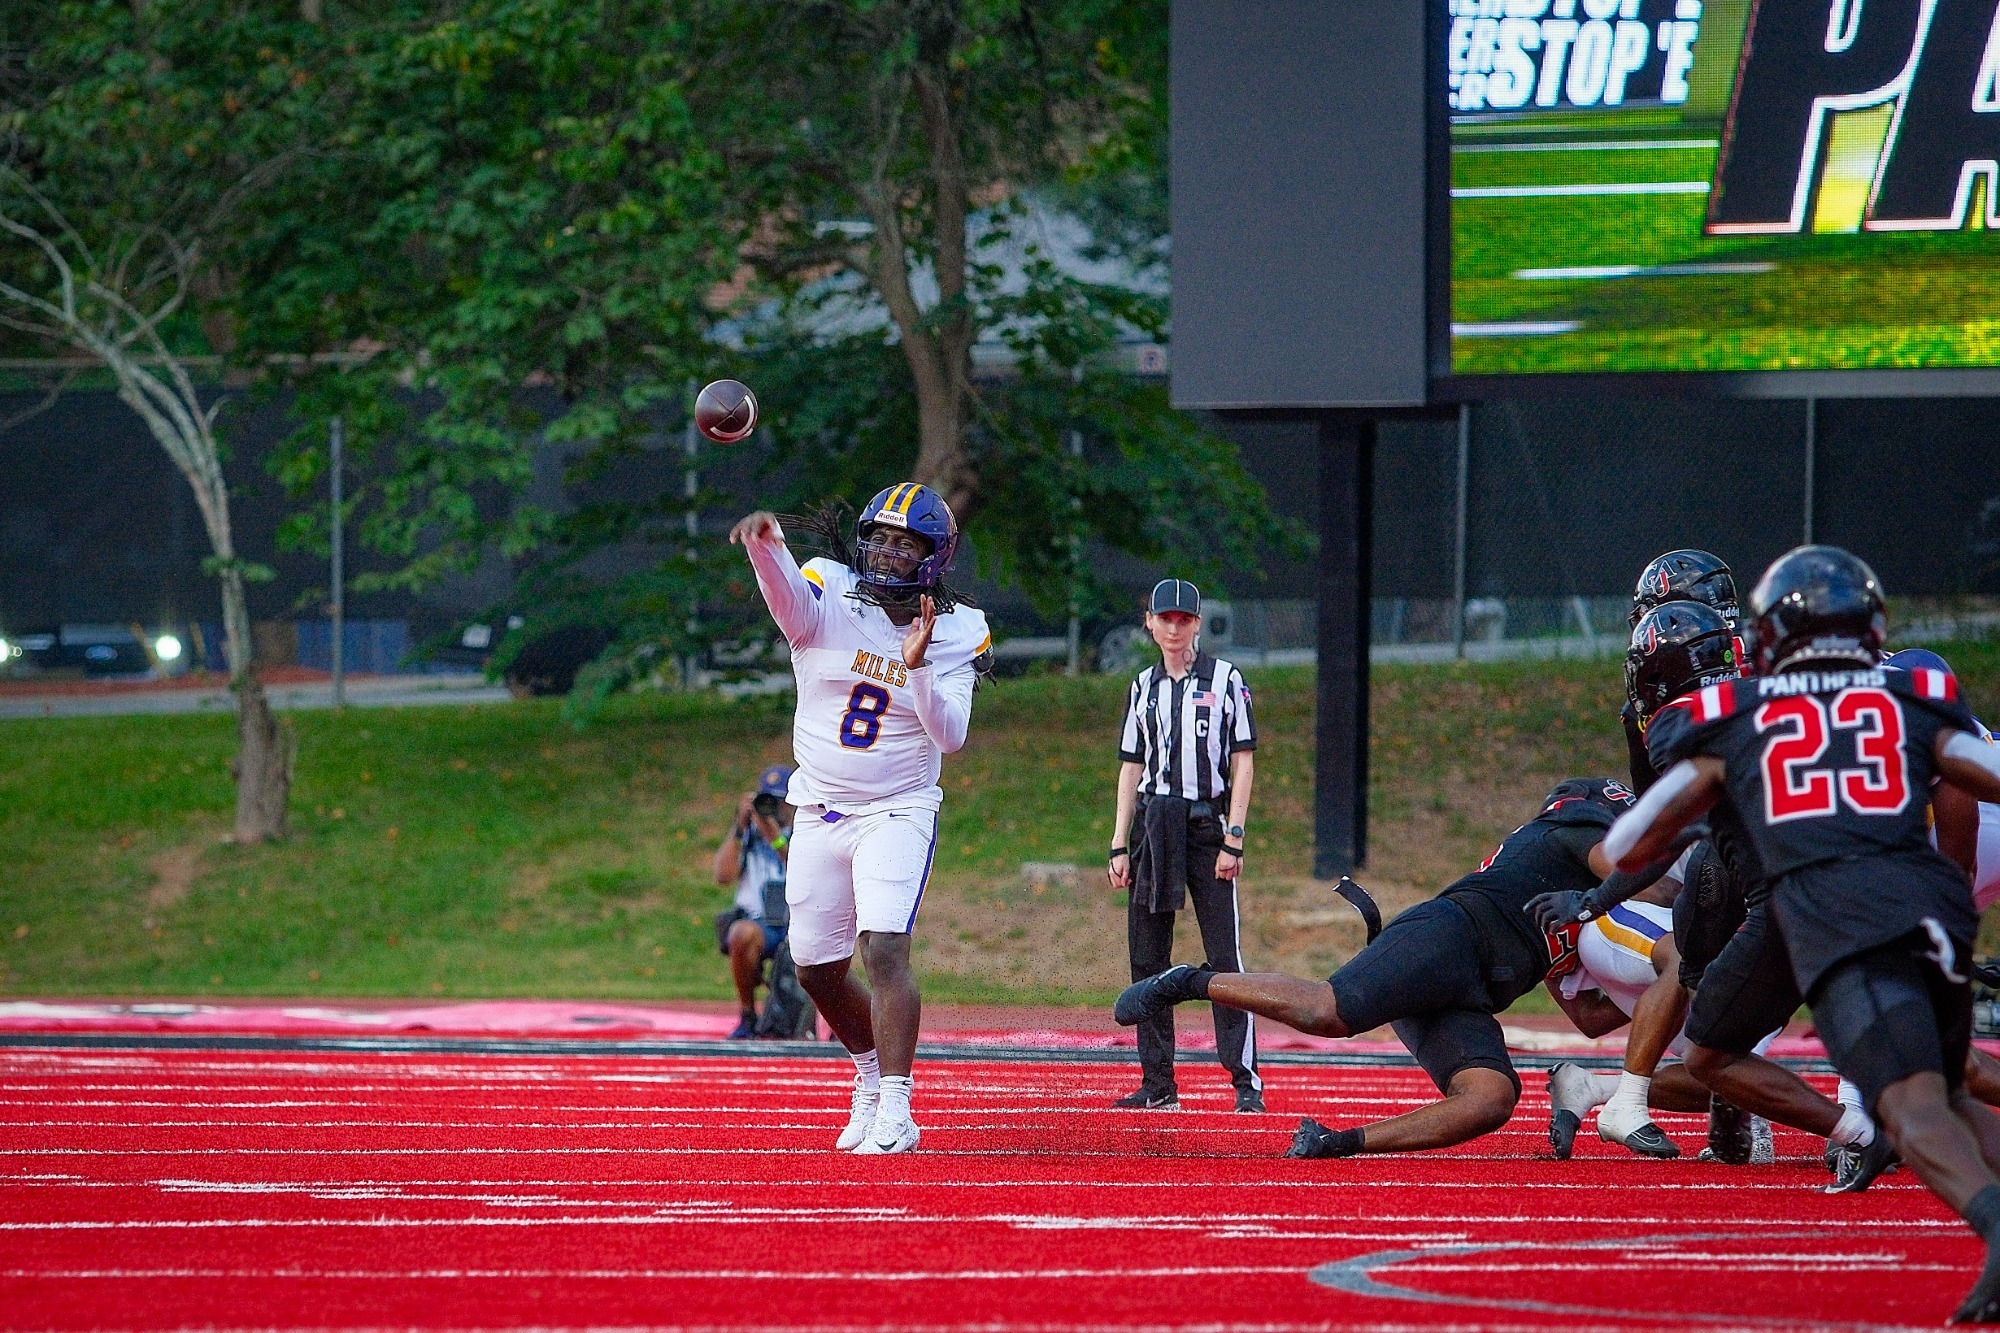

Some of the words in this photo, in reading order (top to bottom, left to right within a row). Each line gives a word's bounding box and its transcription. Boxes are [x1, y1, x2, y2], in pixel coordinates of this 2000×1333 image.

[877, 511, 905, 523] Riddell
[851, 649, 908, 688] MILES
[1757, 670, 1888, 697] PANTHERS
[839, 680, 892, 751] 8
[1196, 719, 1209, 738] C
[1752, 686, 1913, 827] 23
